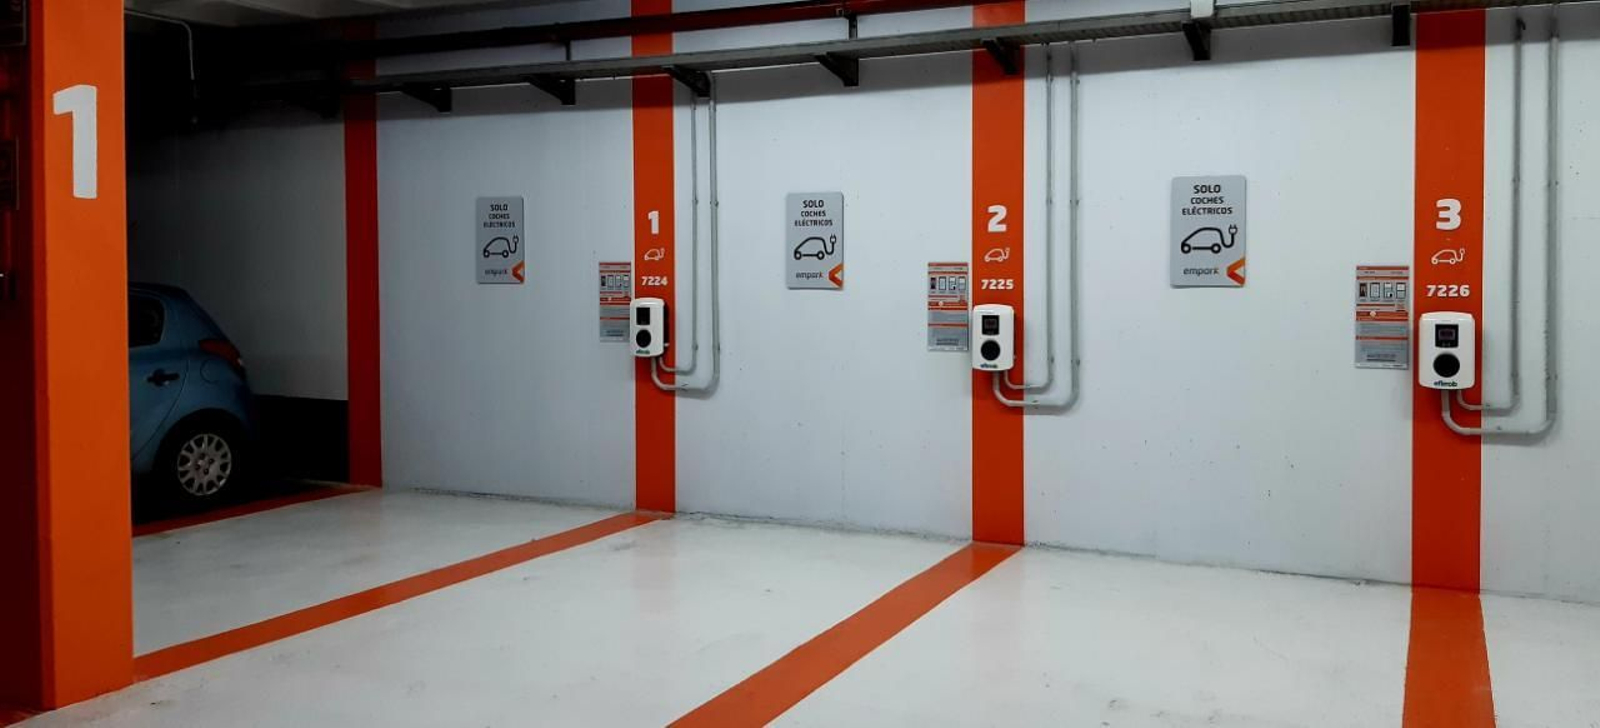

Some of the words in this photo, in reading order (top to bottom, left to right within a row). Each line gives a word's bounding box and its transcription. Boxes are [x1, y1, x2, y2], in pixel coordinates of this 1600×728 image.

[53, 84, 98, 199] 1
[1193, 184, 1221, 194] SOLO
[803, 199, 825, 208] SOLO
[1190, 196, 1225, 205] COCHES
[490, 204, 508, 212] SOLO
[1182, 206, 1233, 215] ELÉCTRICOS
[987, 205, 1007, 232] 2
[1436, 199, 1462, 231] 3
[648, 210, 660, 235] 1
[796, 271, 823, 280] empark
[1183, 267, 1220, 277] empark
[641, 276, 668, 286] 7224
[981, 279, 1014, 290] 7225
[1426, 284, 1470, 297] 7226
